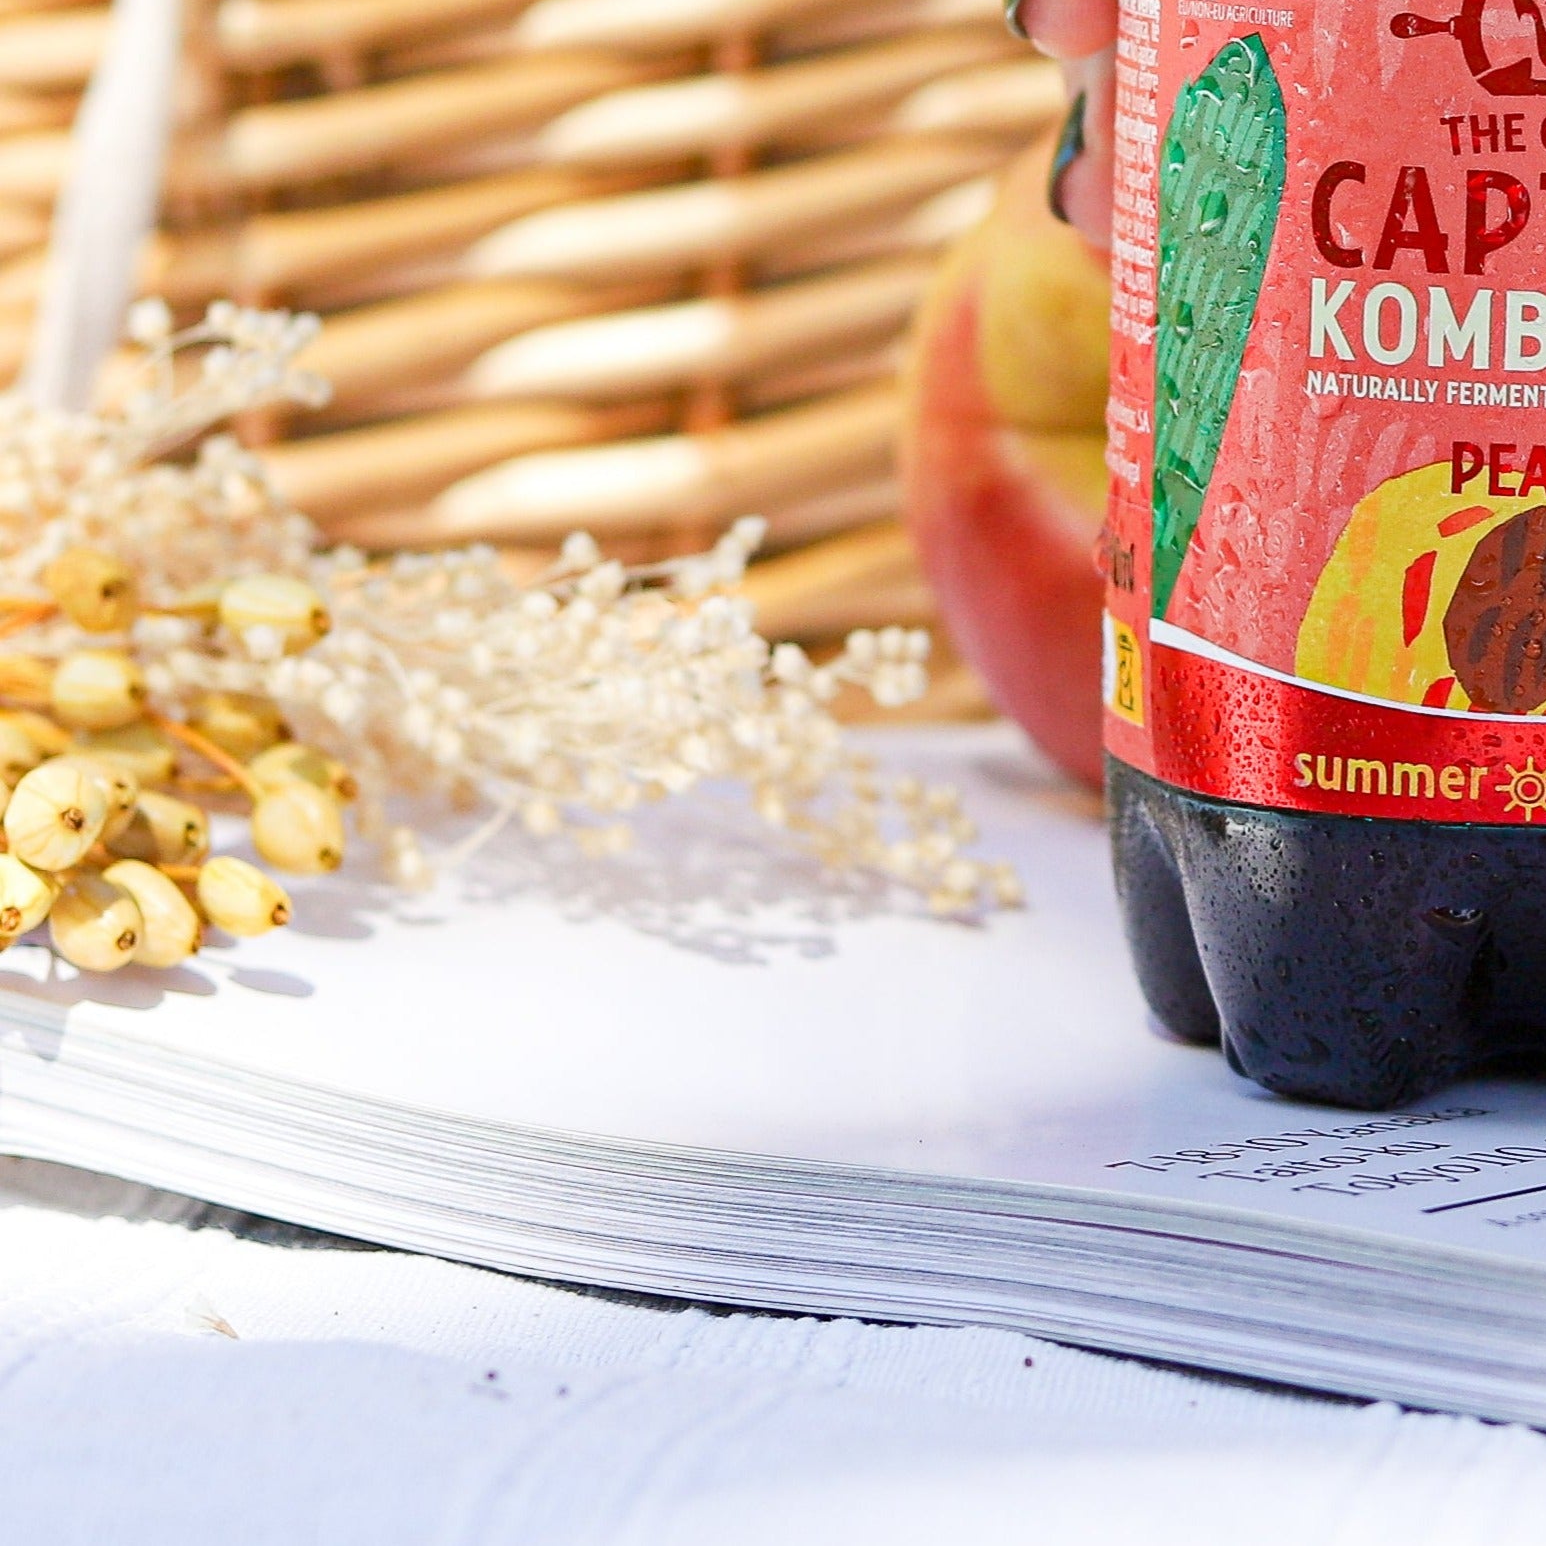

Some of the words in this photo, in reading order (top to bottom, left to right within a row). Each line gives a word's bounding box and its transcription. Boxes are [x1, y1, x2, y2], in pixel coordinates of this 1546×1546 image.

[1227, 6, 1295, 28] AGRICULTURE
[1440, 113, 1527, 155] THE
[1305, 370, 1438, 404] NATURALLY
[1294, 753, 1487, 802] summer
[1105, 1136, 1309, 1172] 7-18-10
[1279, 1107, 1497, 1138] Yanaka
[1198, 1140, 1451, 1183] Taito-ku
[1292, 1163, 1480, 1196] Tokyo
